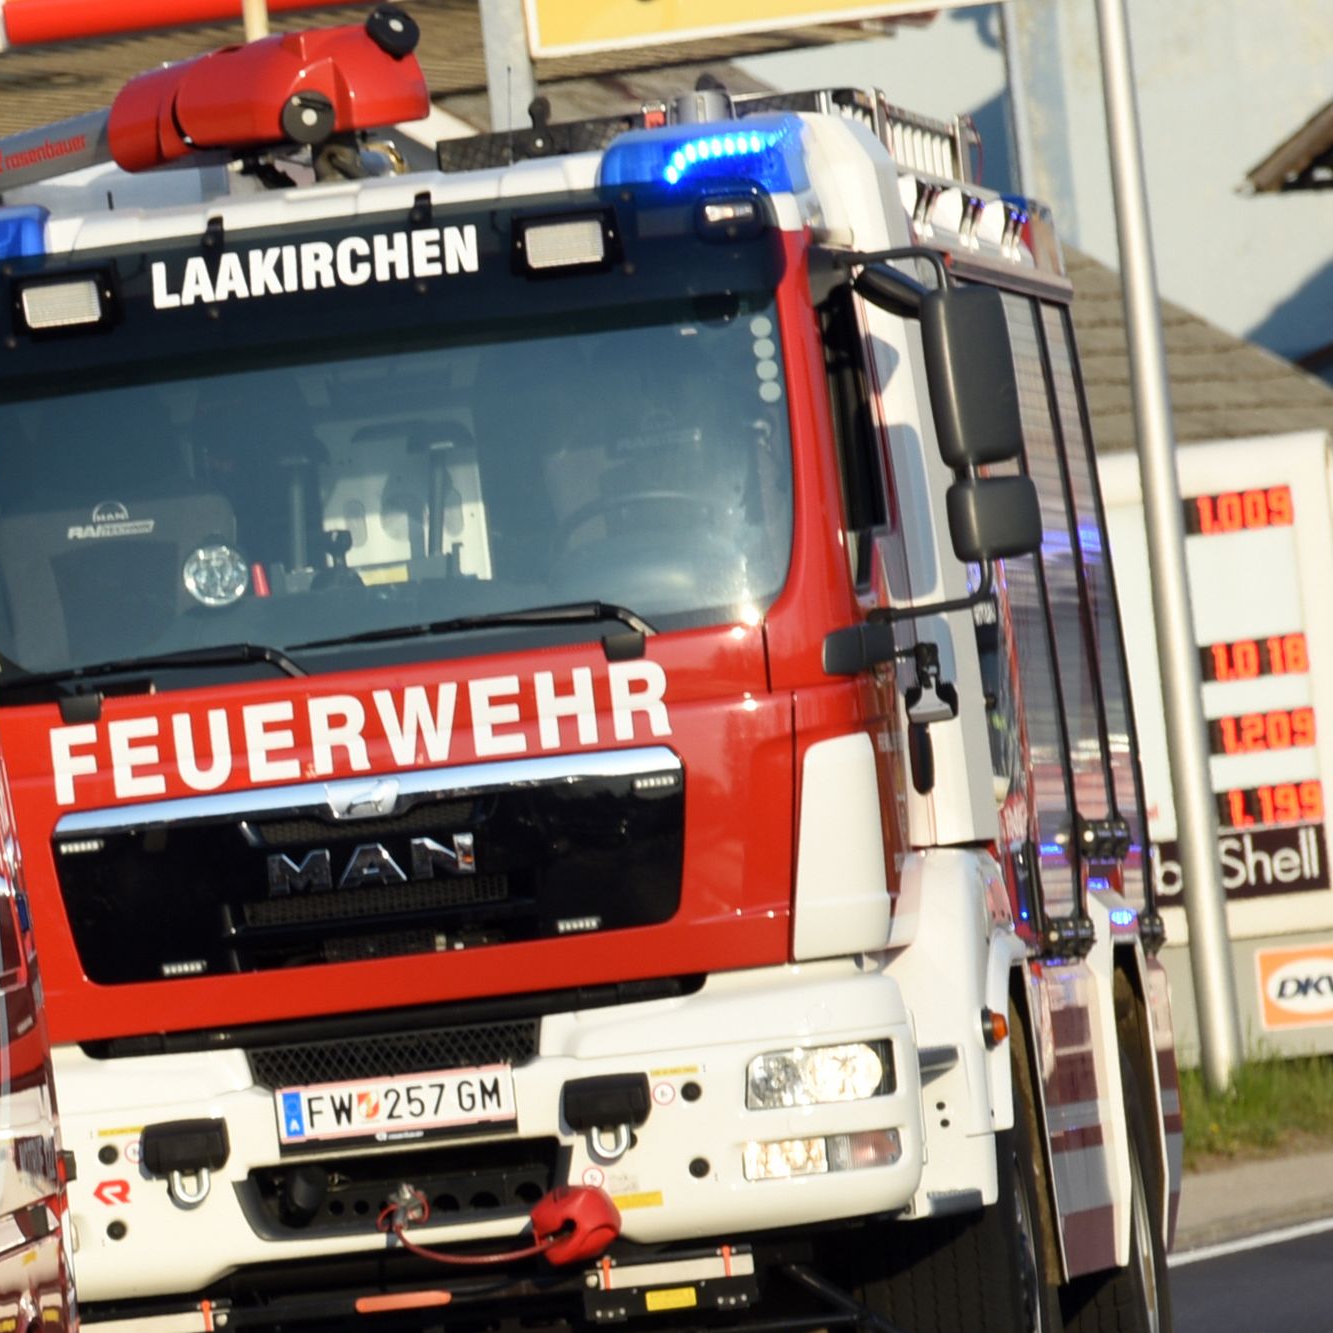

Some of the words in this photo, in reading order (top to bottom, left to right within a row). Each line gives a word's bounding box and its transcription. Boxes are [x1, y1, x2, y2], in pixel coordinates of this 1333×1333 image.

[4, 133, 86, 170] rosenbauer
[151, 225, 479, 310] LAAKIRCHEN
[1196, 484, 1294, 536] 1.009
[48, 659, 673, 806] FEUERWEHR
[1220, 706, 1317, 755] 1.209
[1228, 778, 1325, 829] 1.199
[266, 832, 476, 897] MAN
[1218, 826, 1321, 889] Shell
[307, 1092, 352, 1129] FW
[383, 1083, 446, 1121] 257
[457, 1076, 502, 1112] GM
